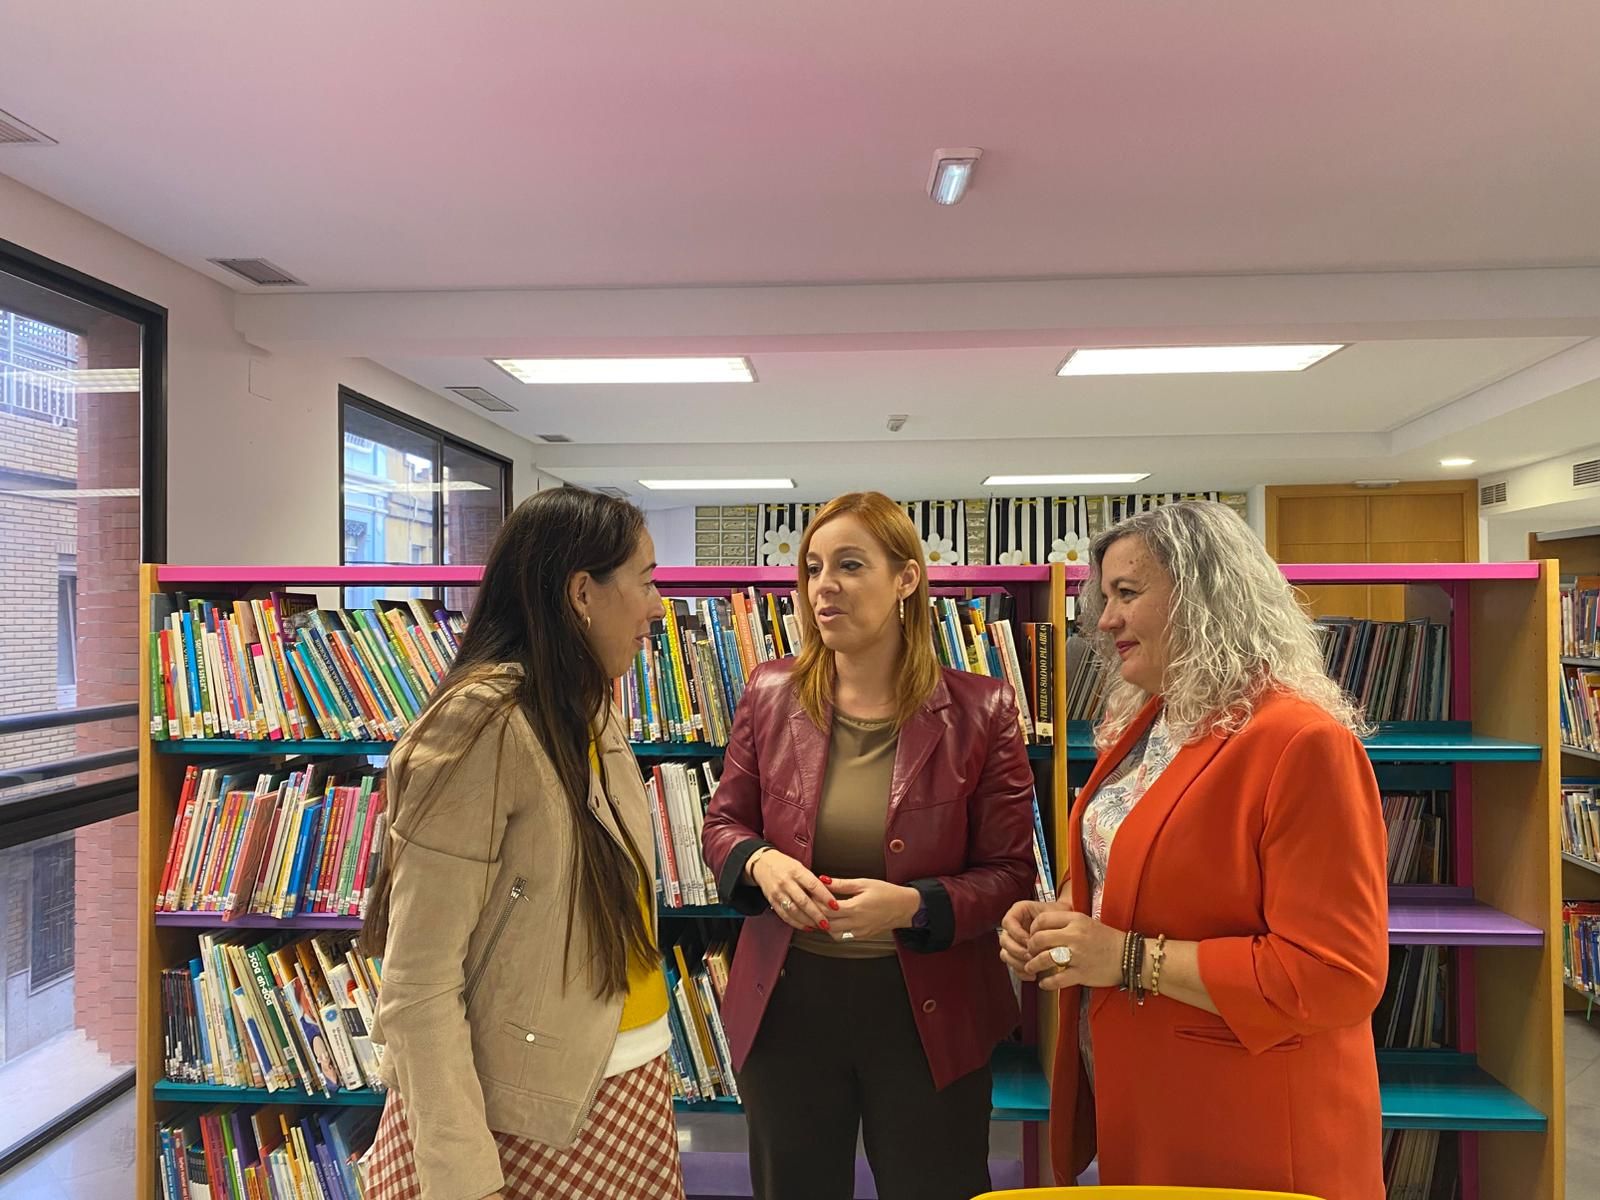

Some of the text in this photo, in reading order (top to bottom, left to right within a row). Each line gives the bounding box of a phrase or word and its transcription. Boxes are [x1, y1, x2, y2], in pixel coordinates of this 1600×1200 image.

[1039, 624, 1047, 659] PALABRAS
[337, 684, 354, 712] CUENTOS
[1040, 688, 1048, 719] PRIMERAS
[248, 951, 262, 975] BOSC
[256, 974, 272, 1006] POP-UP
